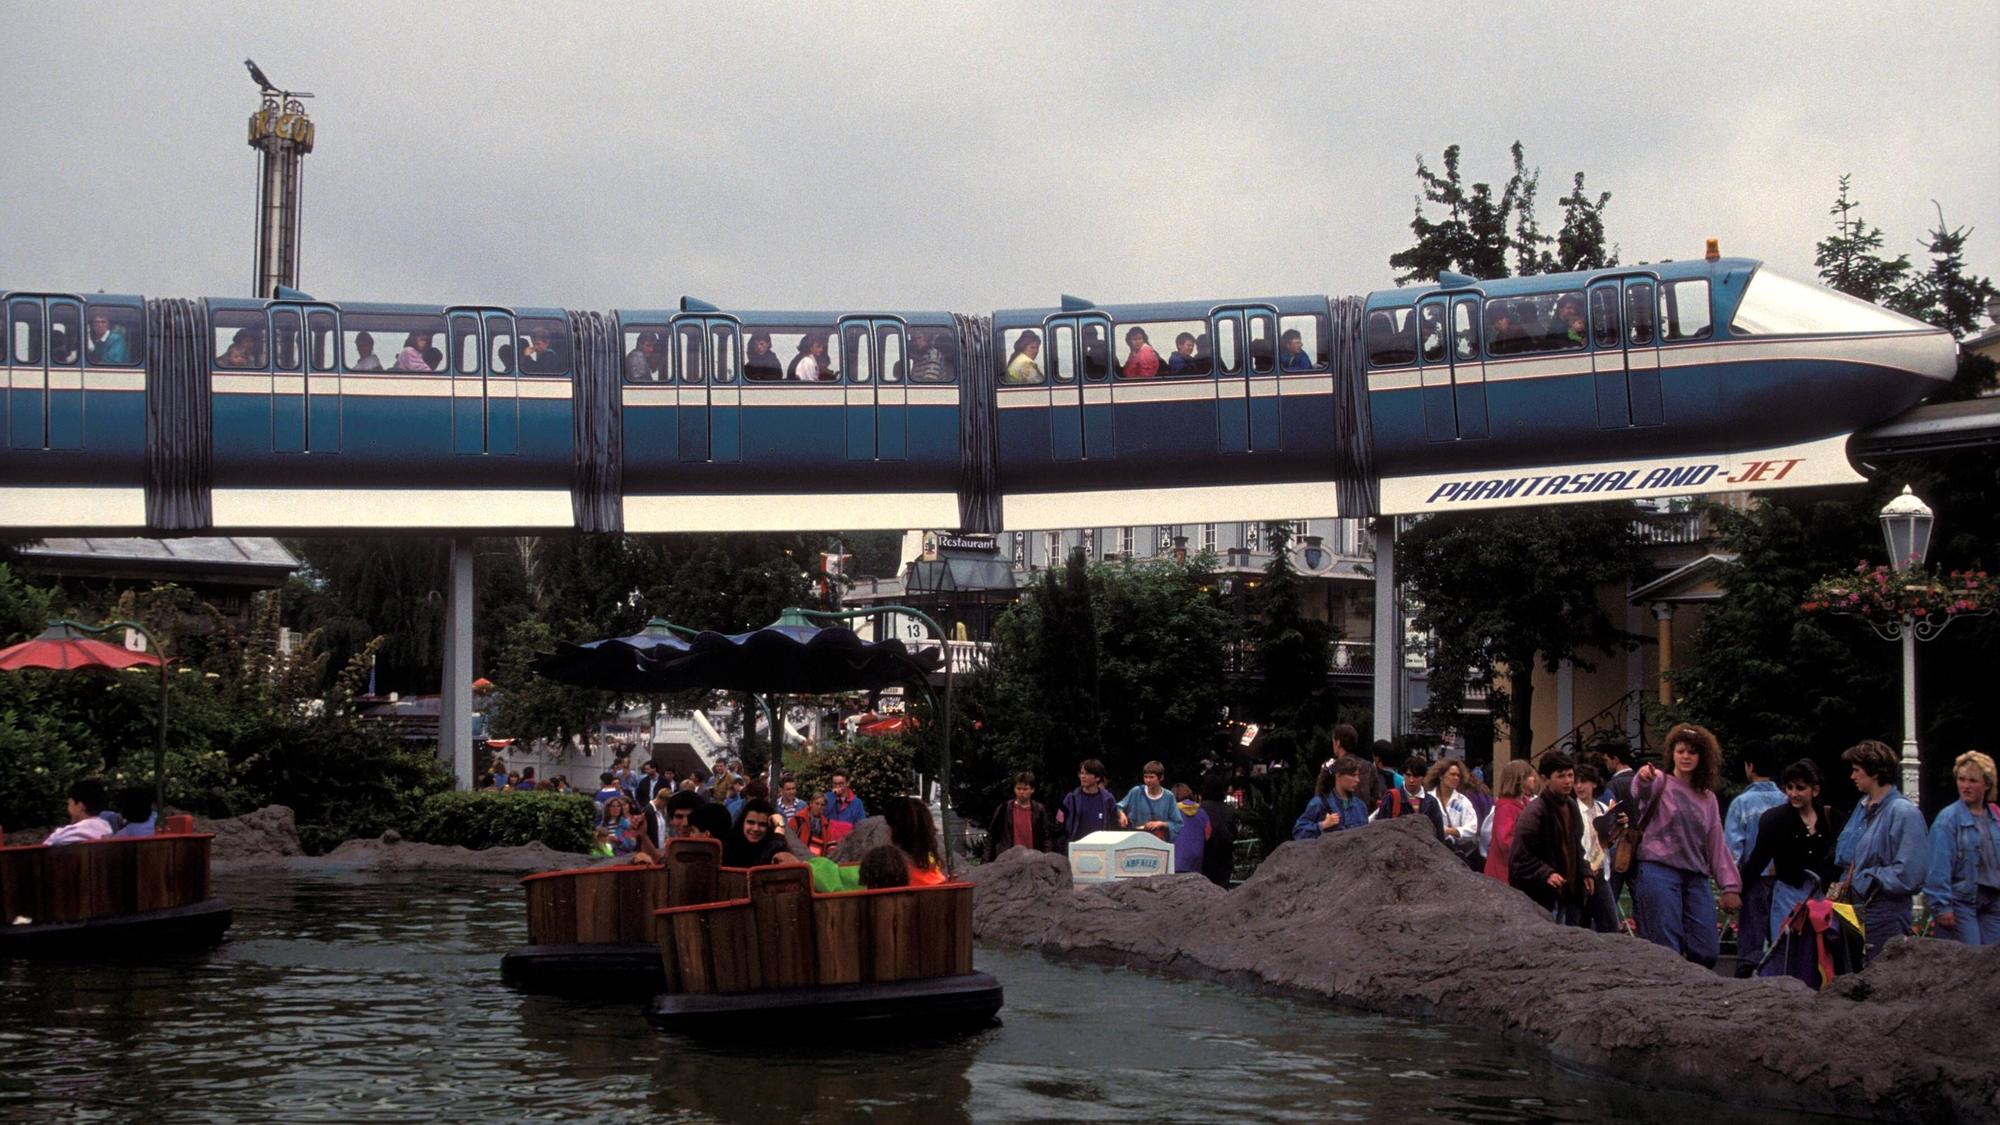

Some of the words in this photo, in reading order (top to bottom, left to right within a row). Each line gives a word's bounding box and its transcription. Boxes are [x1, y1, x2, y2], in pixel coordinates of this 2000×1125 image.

[1425, 458, 1806, 503] PHANTASIALAND-JET
[938, 535, 994, 549] Restaurant
[907, 624, 921, 639] 13
